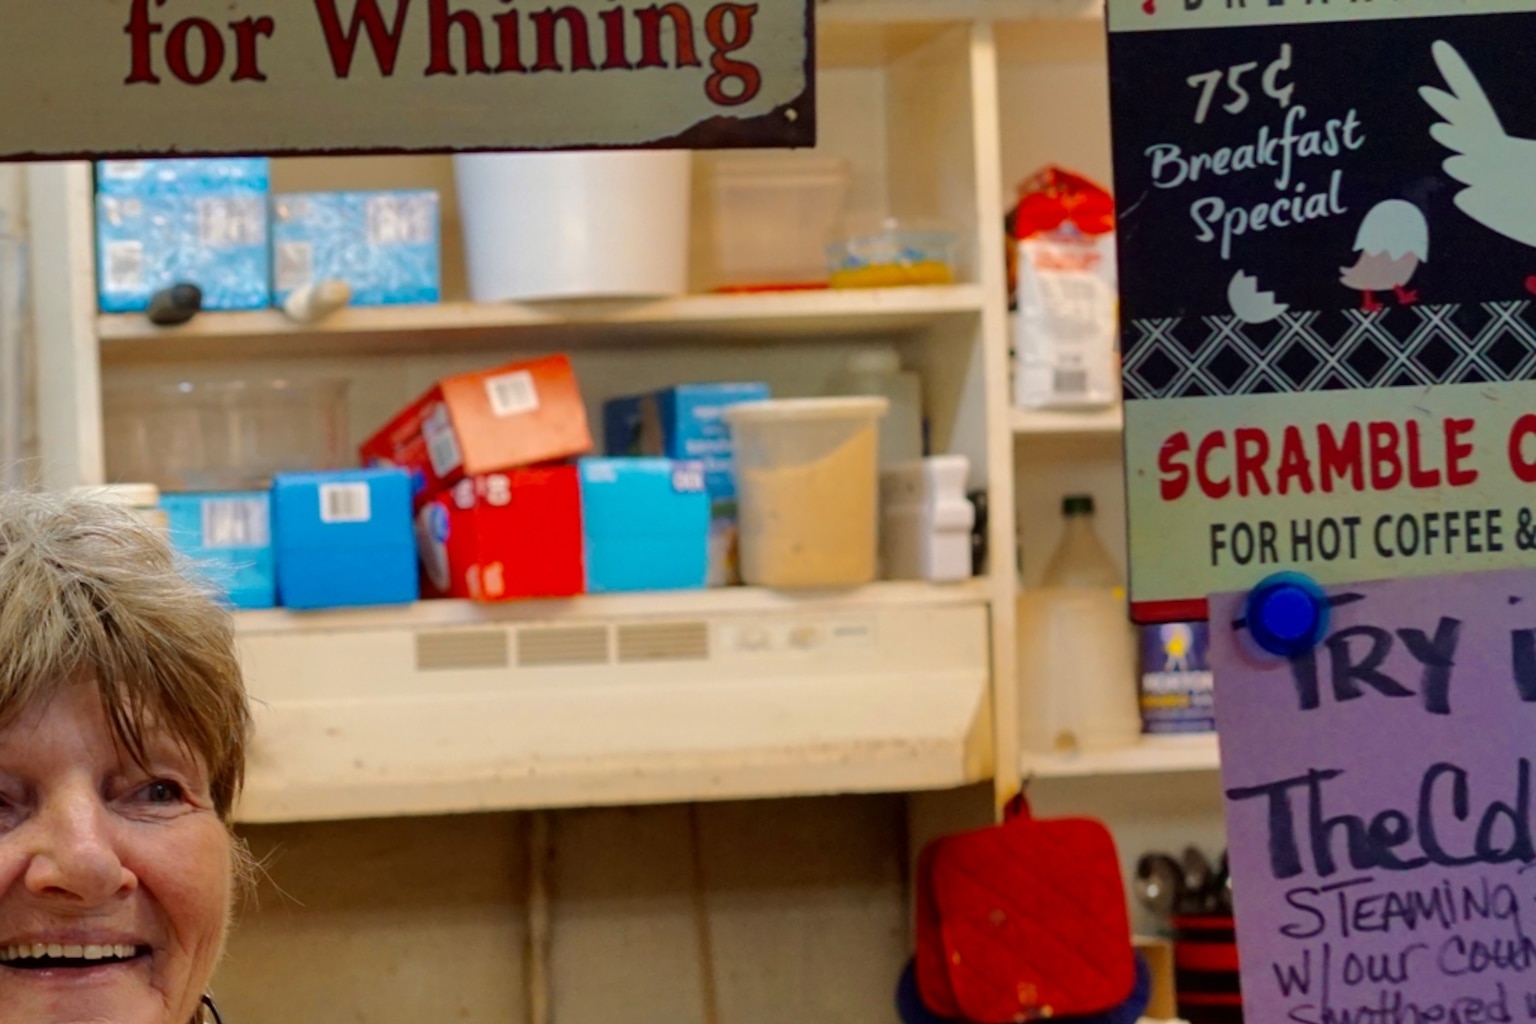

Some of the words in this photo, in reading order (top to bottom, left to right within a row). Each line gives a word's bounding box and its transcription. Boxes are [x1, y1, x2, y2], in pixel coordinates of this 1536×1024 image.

[124, 0, 275, 85] for
[313, 0, 762, 106] Whining
[1144, 105, 1365, 189] Breakfast
[1189, 169, 1349, 260] Special
[1157, 416, 1479, 501] SCRAMBLE
[1210, 520, 1279, 566] FOR
[1291, 516, 1361, 562] HOT
[1374, 509, 1504, 558] COFFEE
